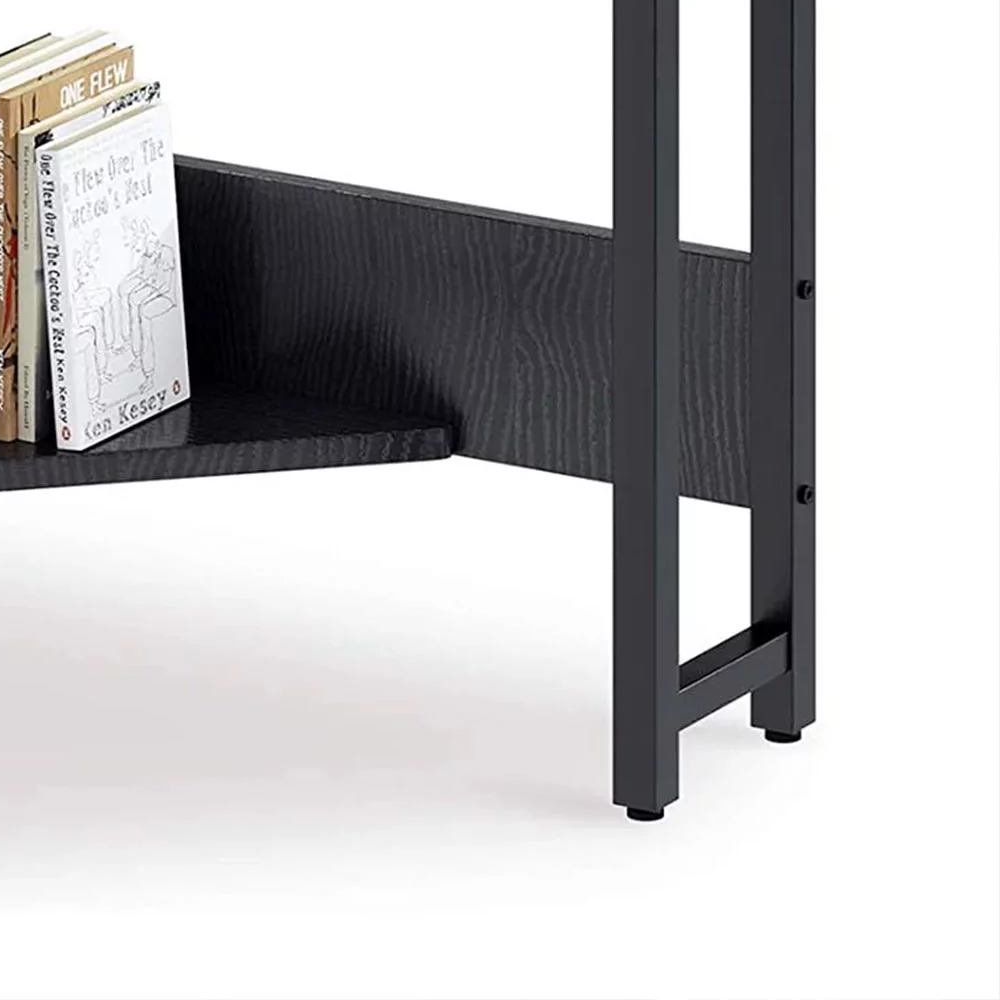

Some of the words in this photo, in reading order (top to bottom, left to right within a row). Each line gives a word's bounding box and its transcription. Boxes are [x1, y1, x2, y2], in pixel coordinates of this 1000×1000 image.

[60, 77, 86, 108] ONE
[90, 59, 128, 95] FLEW
[41, 154, 53, 176] One
[43, 180, 55, 210] Flew
[45, 213, 58, 240] Over
[47, 244, 60, 265] The
[56, 358, 66, 381] Ken
[58, 386, 68, 424] Kesey
[118, 389, 167, 425] Kesey
